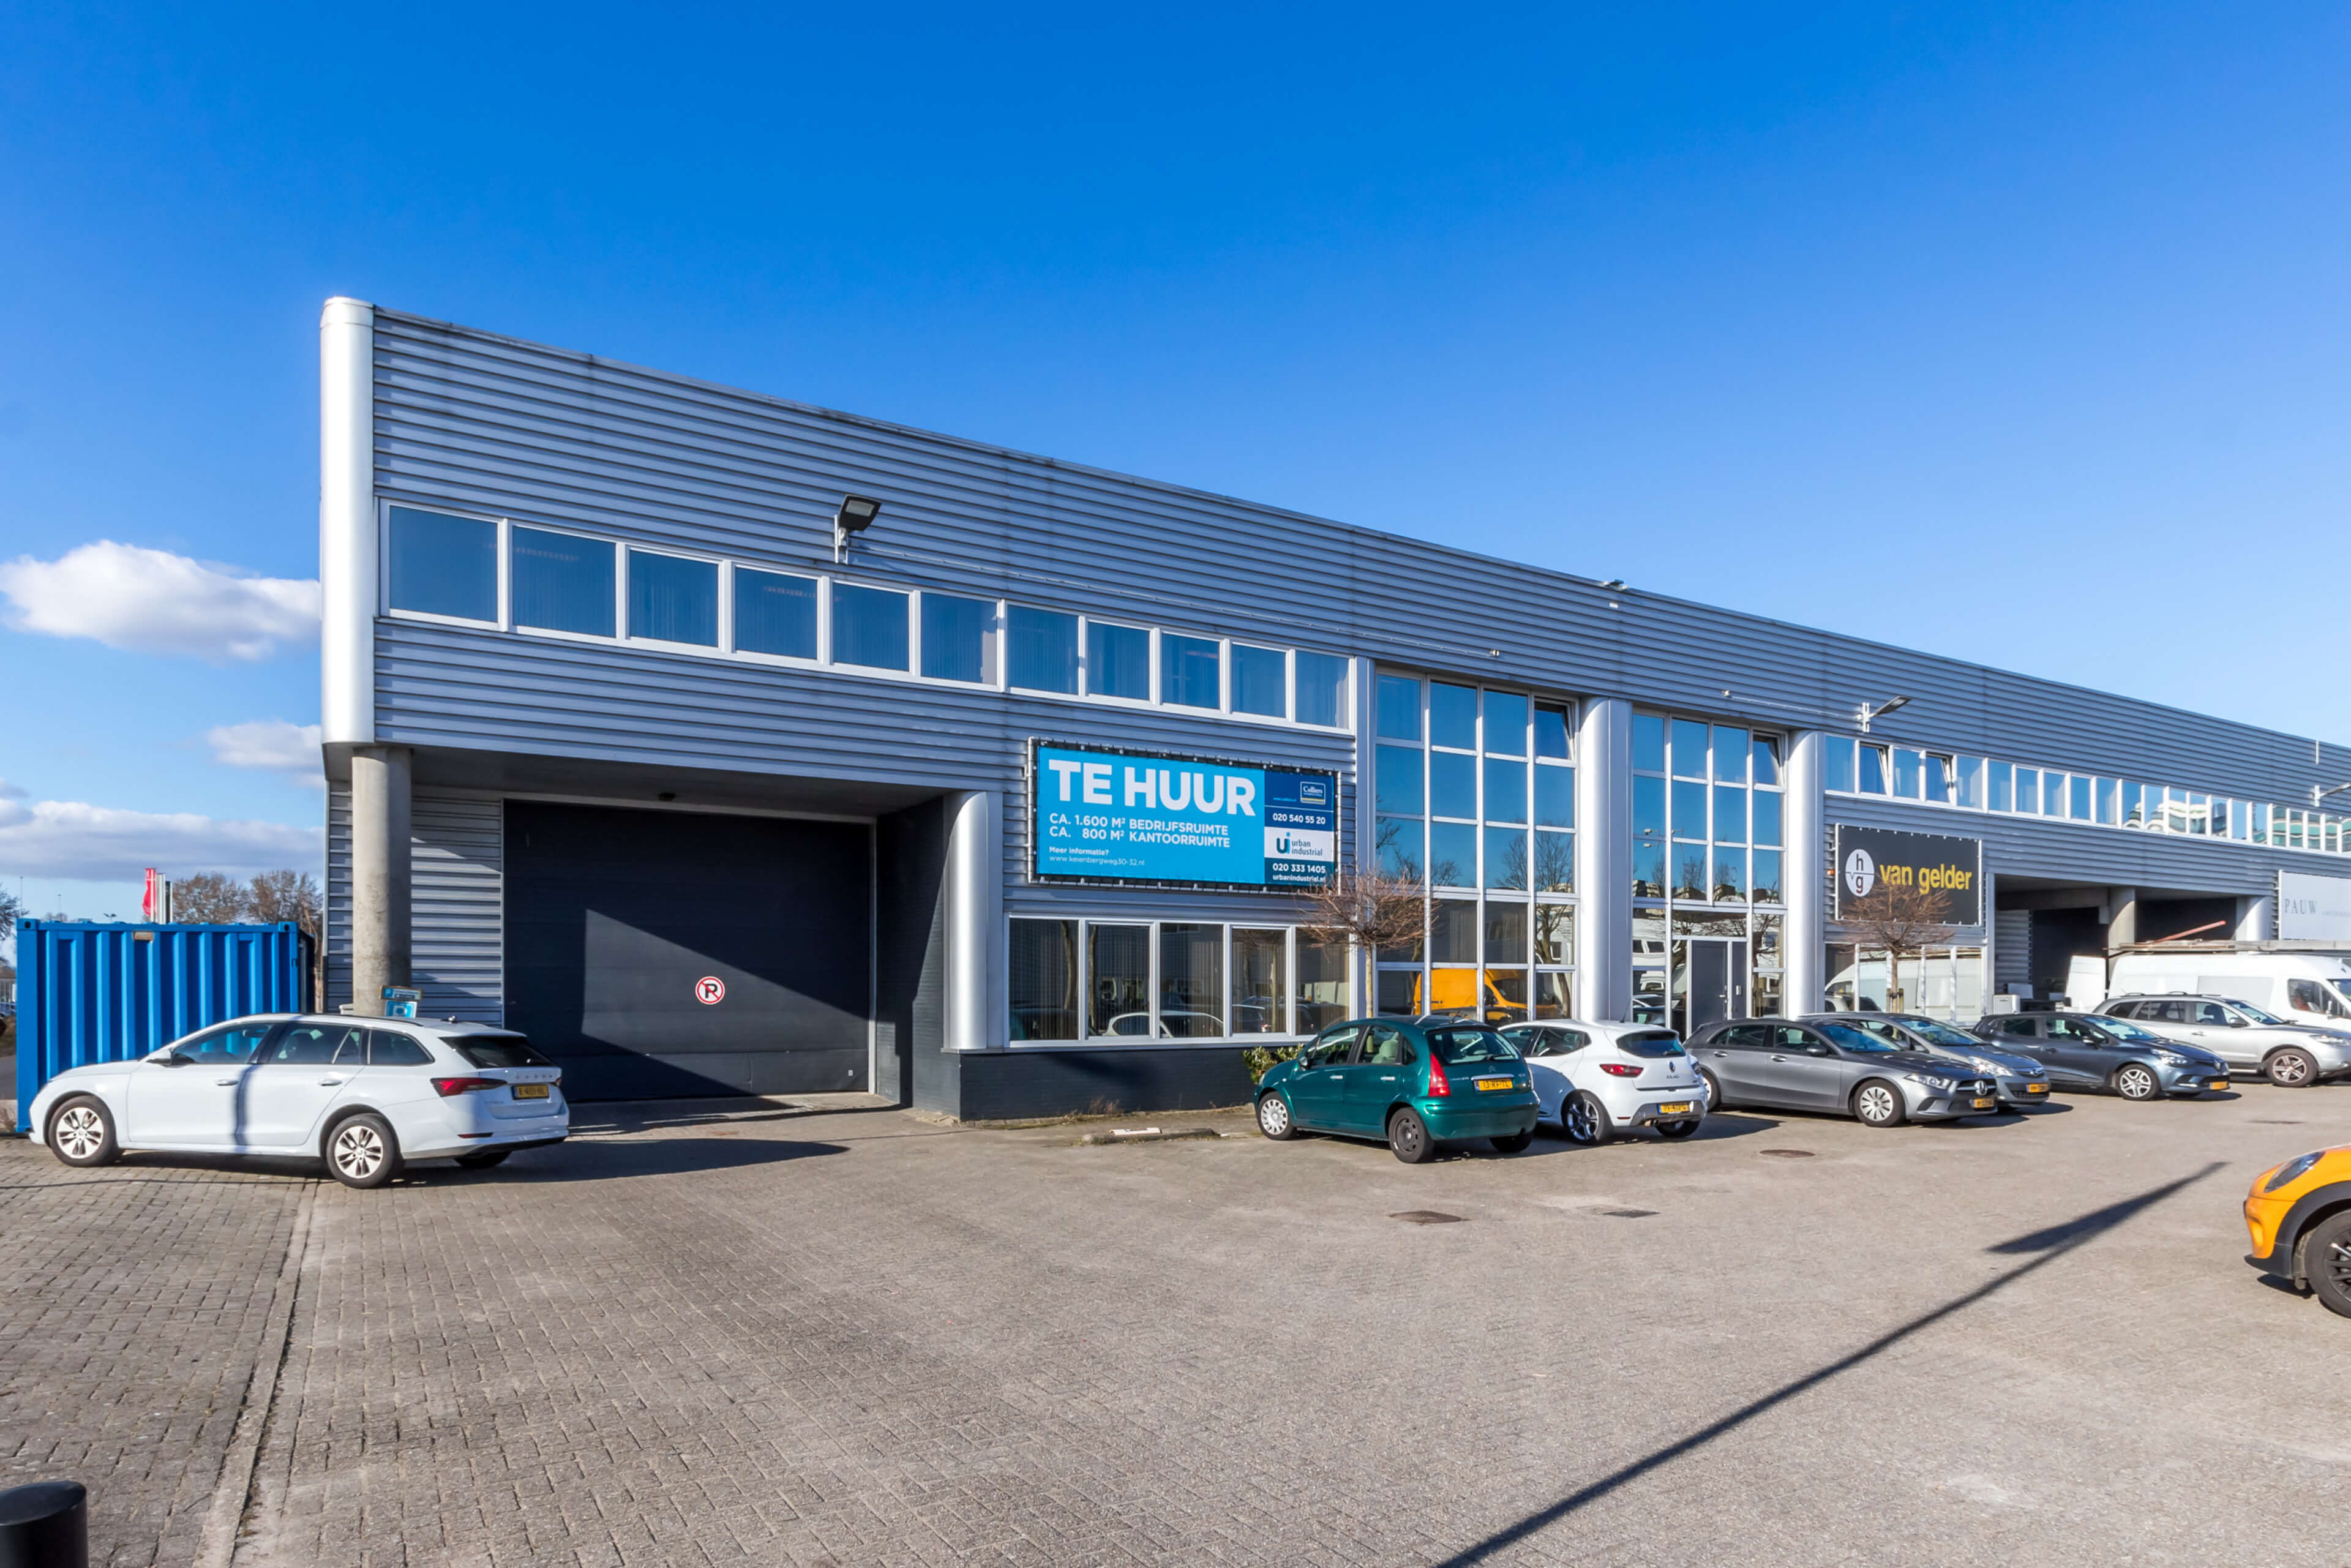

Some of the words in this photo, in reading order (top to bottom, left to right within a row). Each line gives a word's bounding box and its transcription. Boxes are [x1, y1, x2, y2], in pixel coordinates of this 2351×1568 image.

[1049, 759, 1112, 805] TE
[1125, 767, 1256, 817] HUUR
[1049, 812, 1071, 825] CA.
[1074, 815, 1108, 827] 1.600
[1129, 818, 1228, 836] BEDRIJFSRUIMTE
[1273, 812, 1288, 822] 020
[1289, 814, 1303, 823] 540
[1049, 825, 1071, 838] CA.
[1082, 828, 1107, 840] 800
[1129, 831, 1230, 848] KANTOORRUIMTE
[1273, 863, 1289, 871] 020
[1291, 864, 1305, 872] 333
[1307, 865, 1326, 874] 1405
[1880, 864, 1913, 886] van
[1918, 863, 1973, 895] gelder
[2284, 898, 2317, 915] PAUW
